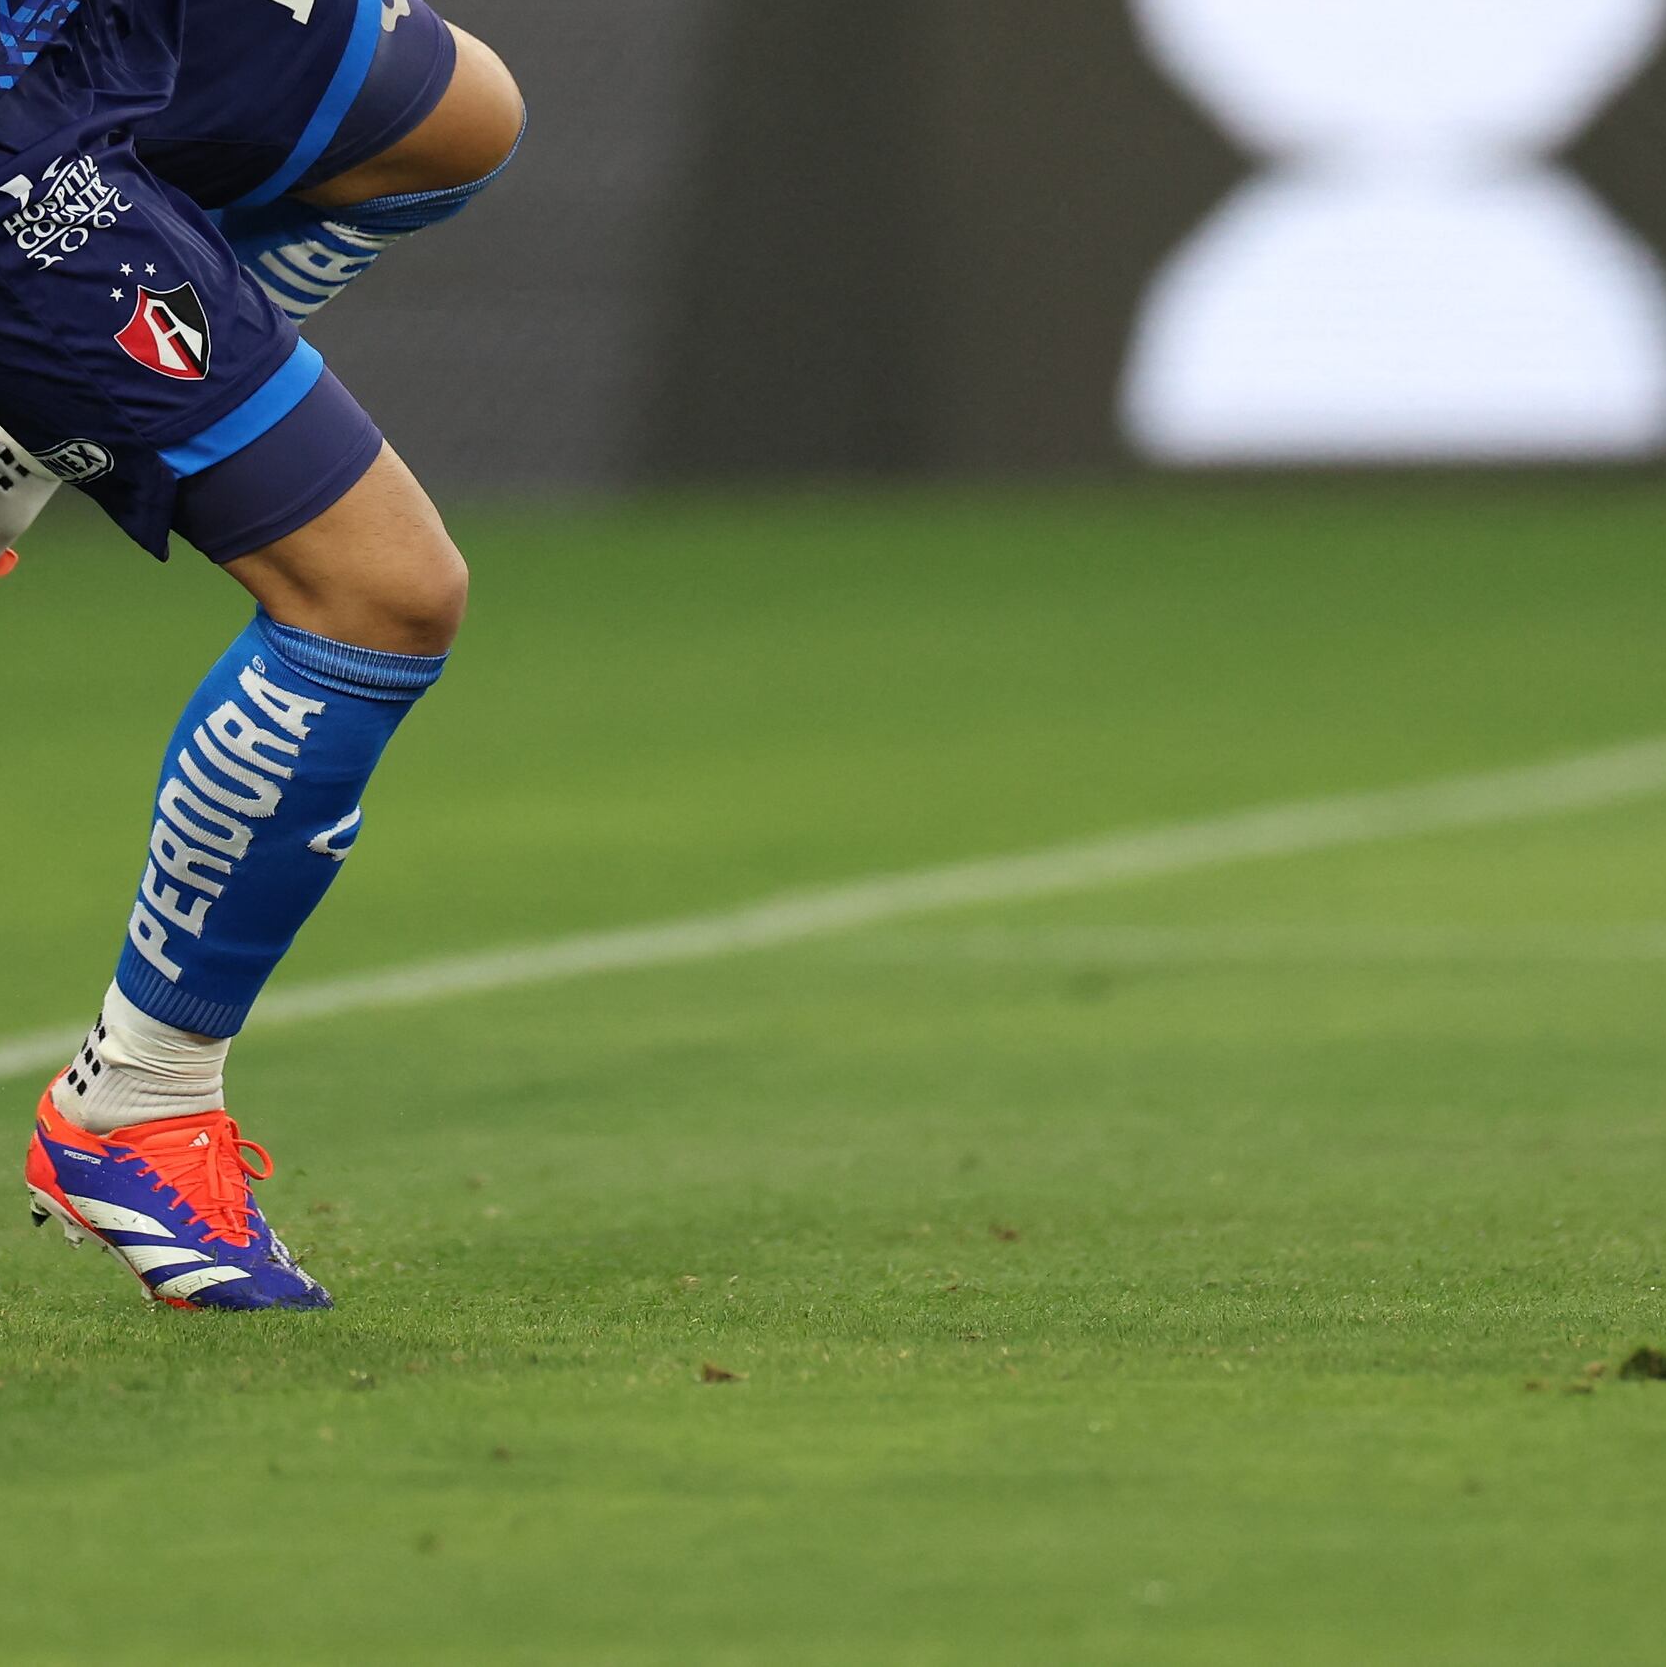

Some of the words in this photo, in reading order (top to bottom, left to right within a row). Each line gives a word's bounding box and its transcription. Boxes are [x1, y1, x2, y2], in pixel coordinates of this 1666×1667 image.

[17, 172, 110, 250] COUNTR
[128, 665, 326, 984] PERDURA
[63, 1148, 102, 1165] PREDATOR
